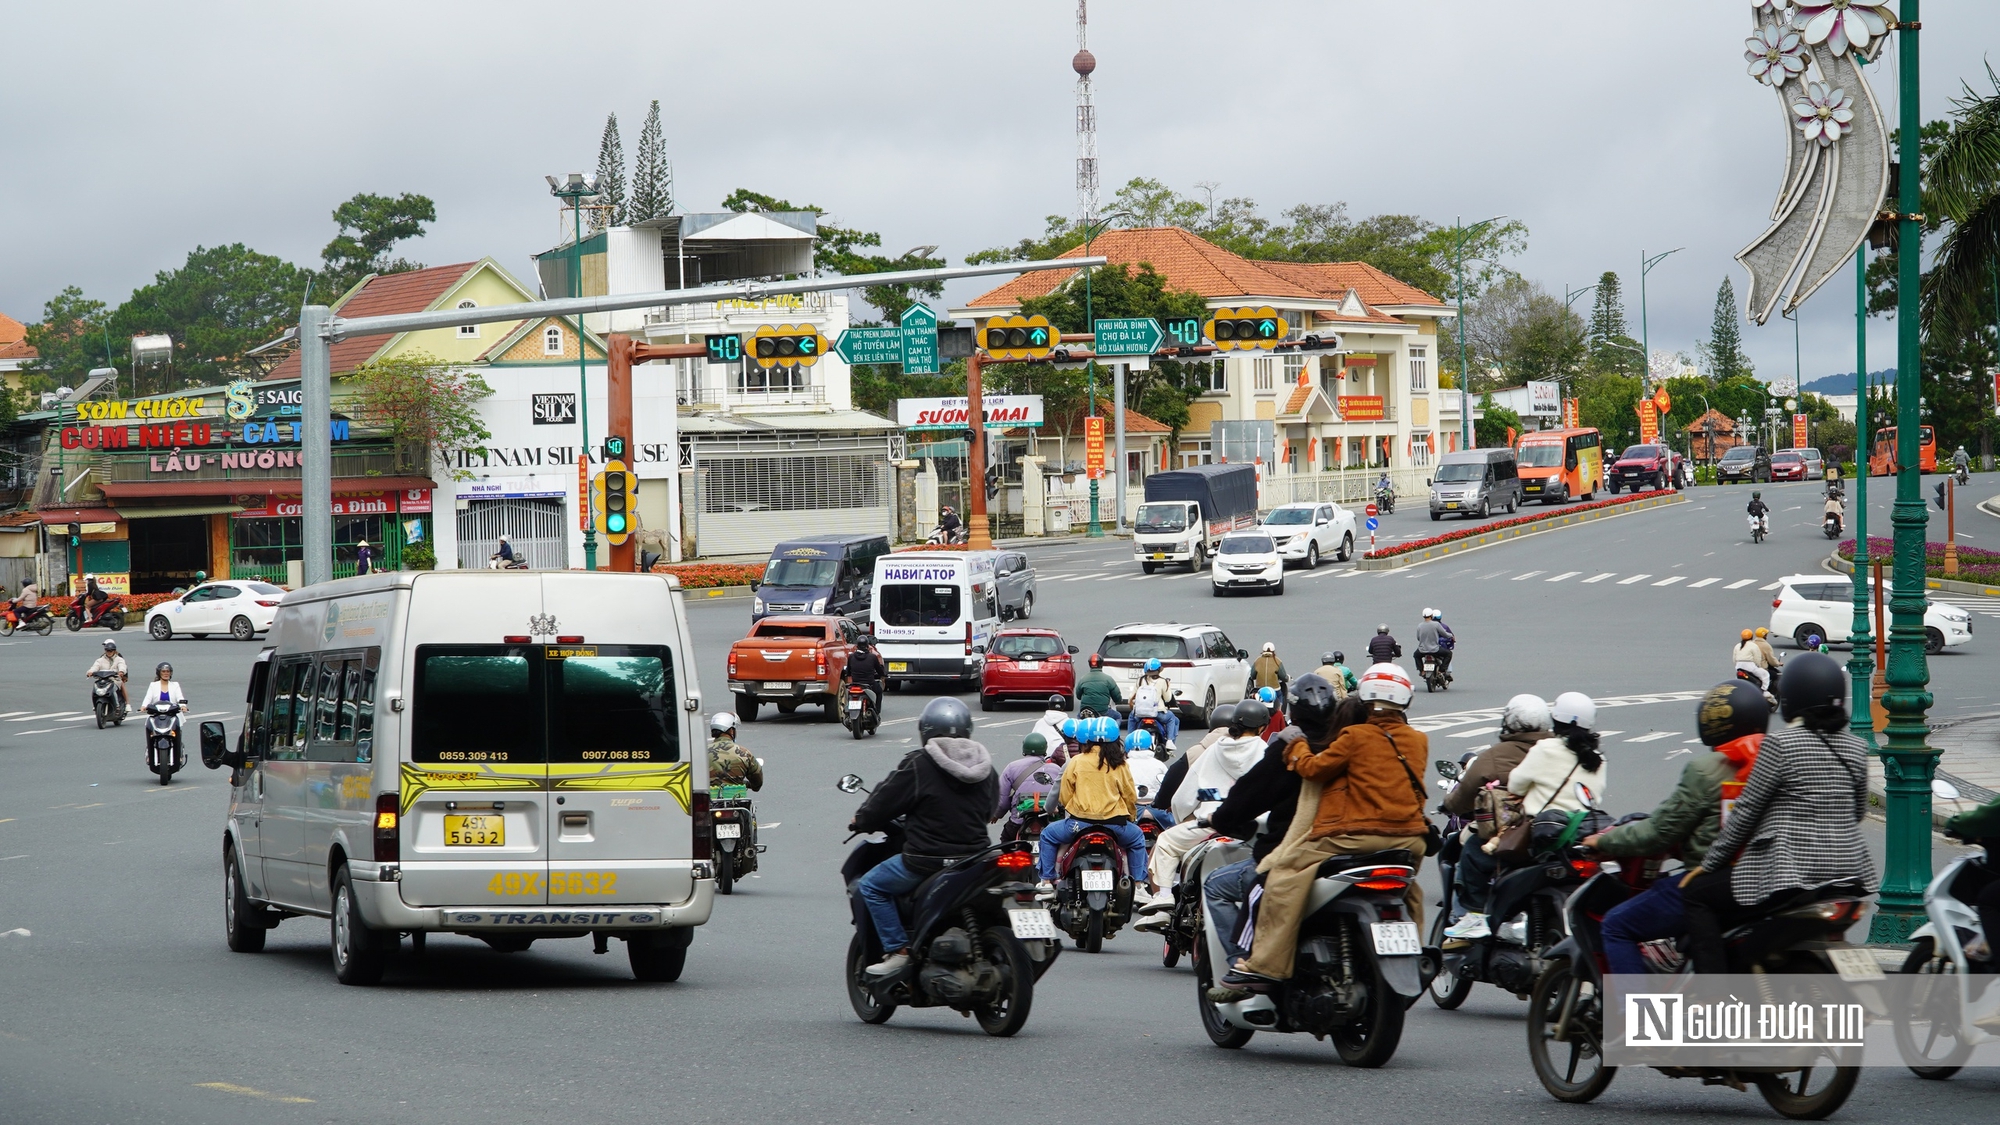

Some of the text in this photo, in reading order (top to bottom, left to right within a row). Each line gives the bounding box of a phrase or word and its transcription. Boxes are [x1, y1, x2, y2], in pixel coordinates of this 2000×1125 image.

[1098, 319, 1147, 330] KHU HÒA BÌNH
[850, 329, 862, 338] THÁC
[1102, 330, 1145, 341] CHỢ ĐÀ LẠT
[1169, 320, 1197, 344] 40
[853, 340, 861, 350] HỒ
[886, 341, 900, 349] LÂM
[911, 336, 928, 345] THÁC
[709, 336, 739, 360] 40
[908, 346, 931, 355] CAM LY
[1098, 341, 1147, 352] HỒ XUÂN HƯƠNG
[854, 352, 863, 362] BẾN
[872, 352, 884, 361] LIÊN
[267, 390, 302, 404] SAIG
[535, 395, 575, 404] VIETNAM
[76, 397, 204, 420] SƠN CƯỚC
[534, 402, 574, 418] SILK
[916, 407, 1029, 424] SƯƠN MAI
[61, 425, 128, 449] CƠM
[139, 420, 211, 447] NIÊU
[243, 416, 280, 443] CÁ
[290, 420, 349, 442] TM
[608, 441, 622, 454] 40
[150, 447, 200, 472] LẨU
[442, 447, 542, 468] VIETNAM
[548, 446, 597, 466] SILK
[349, 500, 387, 513] Đình
[885, 569, 955, 580] НАВИГАТОР
[576, 646, 594, 656] ĐỒNG
[439, 751, 508, 761] 0859.309 413
[582, 750, 650, 760] 0907.068 853
[462, 816, 486, 830] 49X
[490, 914, 620, 924] TRANSIT
